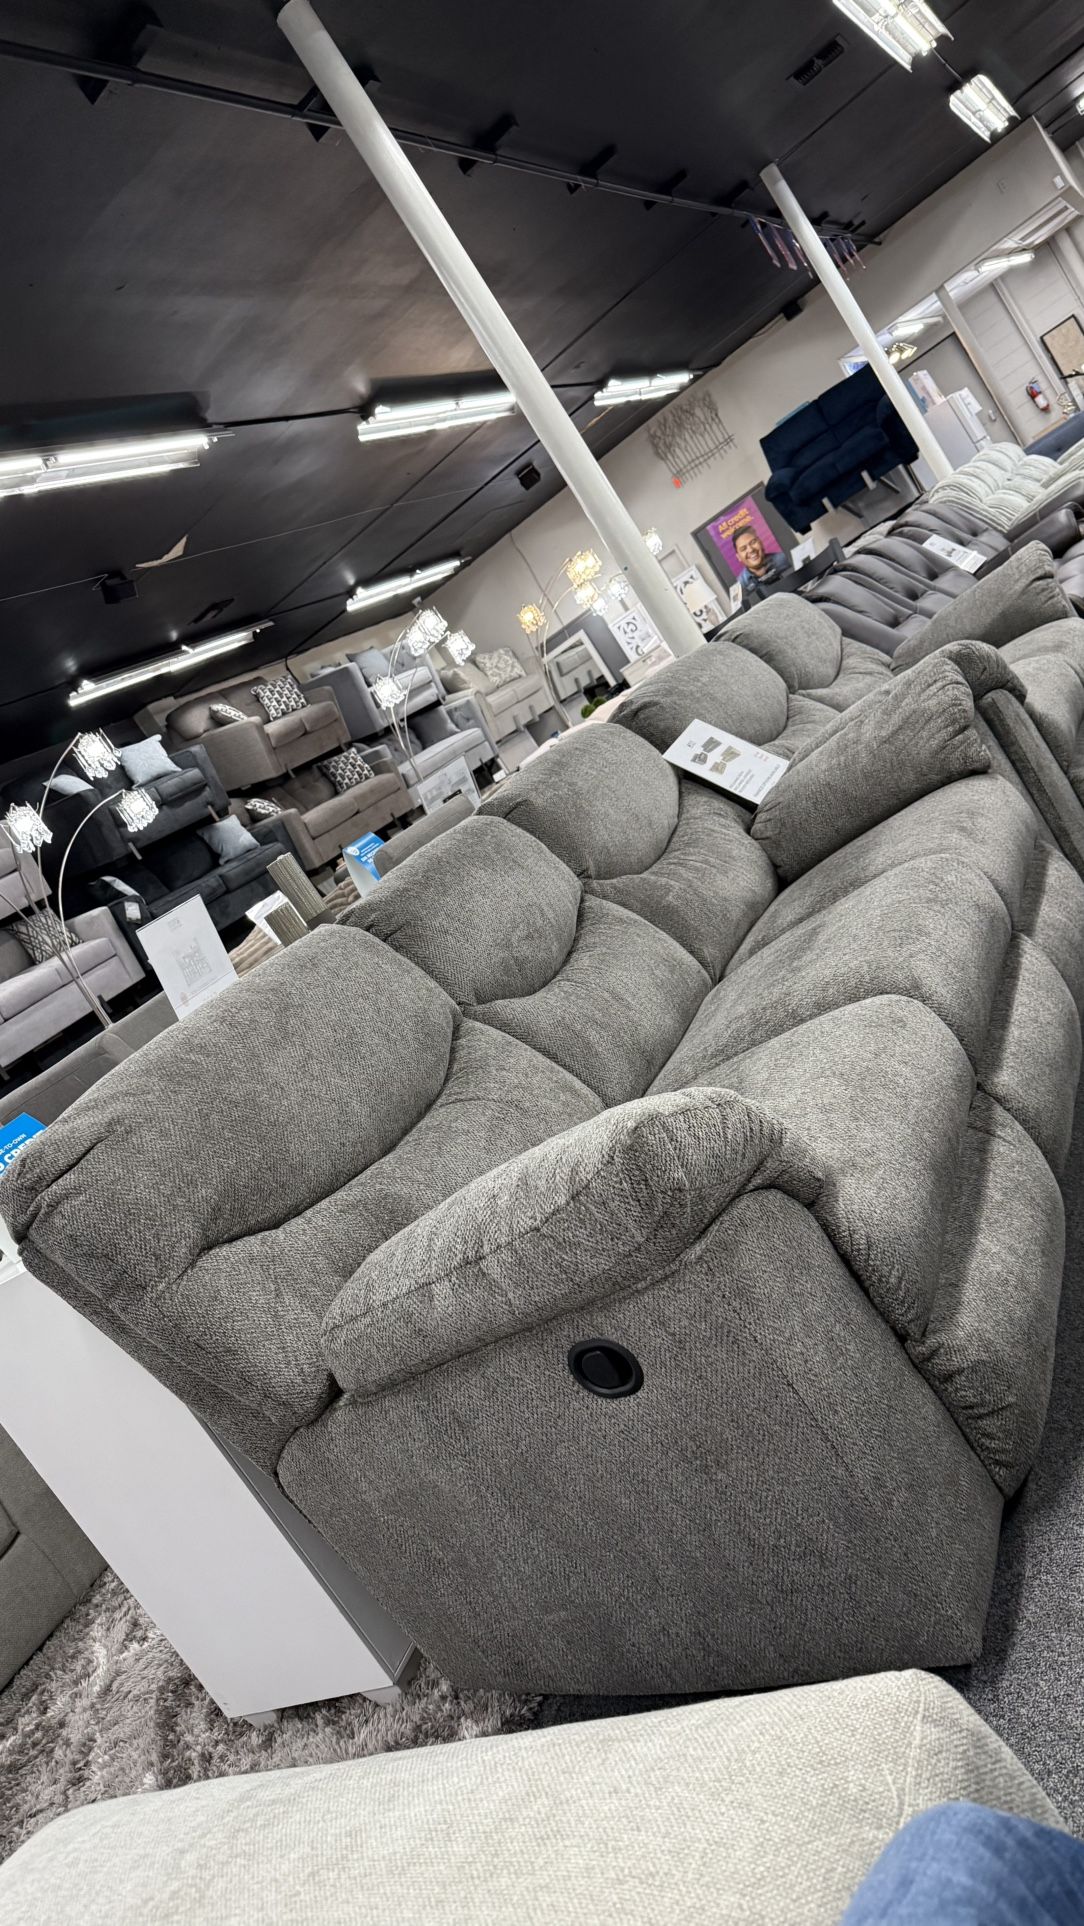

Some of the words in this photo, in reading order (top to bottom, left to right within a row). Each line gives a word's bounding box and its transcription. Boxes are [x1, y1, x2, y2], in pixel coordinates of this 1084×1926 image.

[719, 521, 728, 533] All
[727, 508, 749, 526] credit
[4, 1130, 45, 1163] CRED
